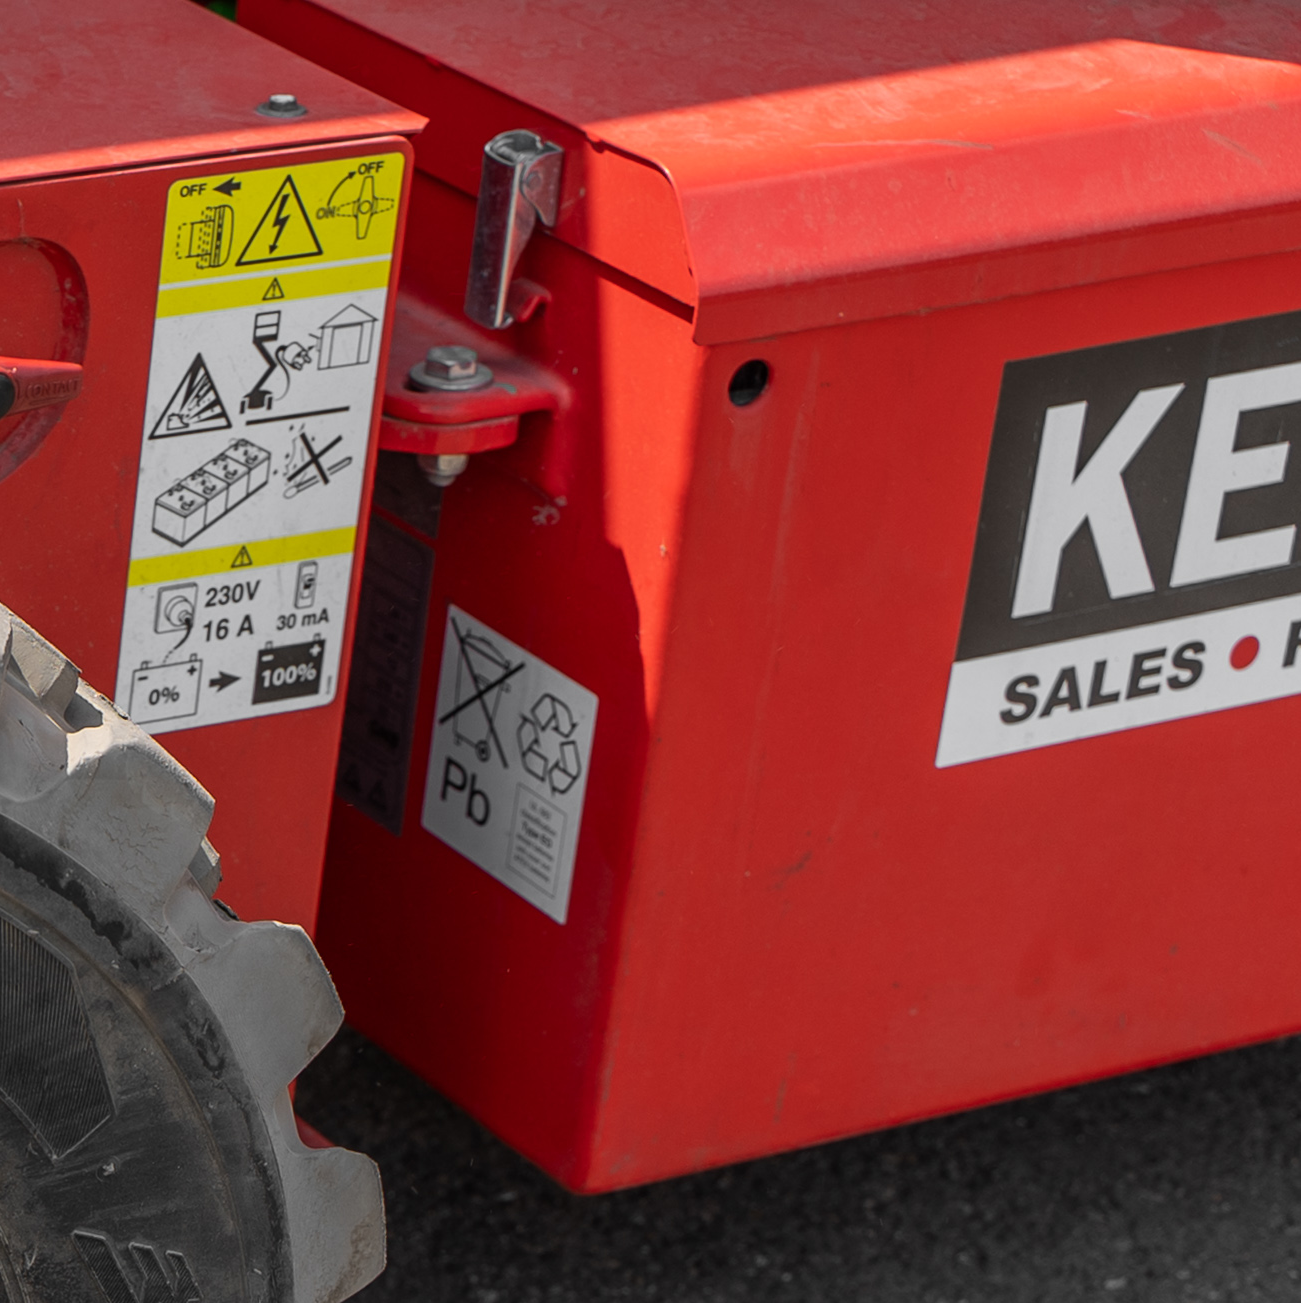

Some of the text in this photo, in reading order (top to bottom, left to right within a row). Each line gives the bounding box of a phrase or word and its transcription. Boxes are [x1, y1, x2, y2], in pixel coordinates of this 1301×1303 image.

[358, 160, 386, 175] OFF
[180, 182, 208, 197] OFF
[316, 206, 336, 220] ON
[26, 378, 80, 399] CONTACT
[204, 579, 261, 608] 230V
[203, 614, 254, 642] 16 A
[276, 607, 330, 631] 30 mA
[261, 662, 318, 688] 100%
[999, 640, 1206, 726] SALES
[148, 686, 180, 706] 0%
[440, 756, 491, 827] Pb
